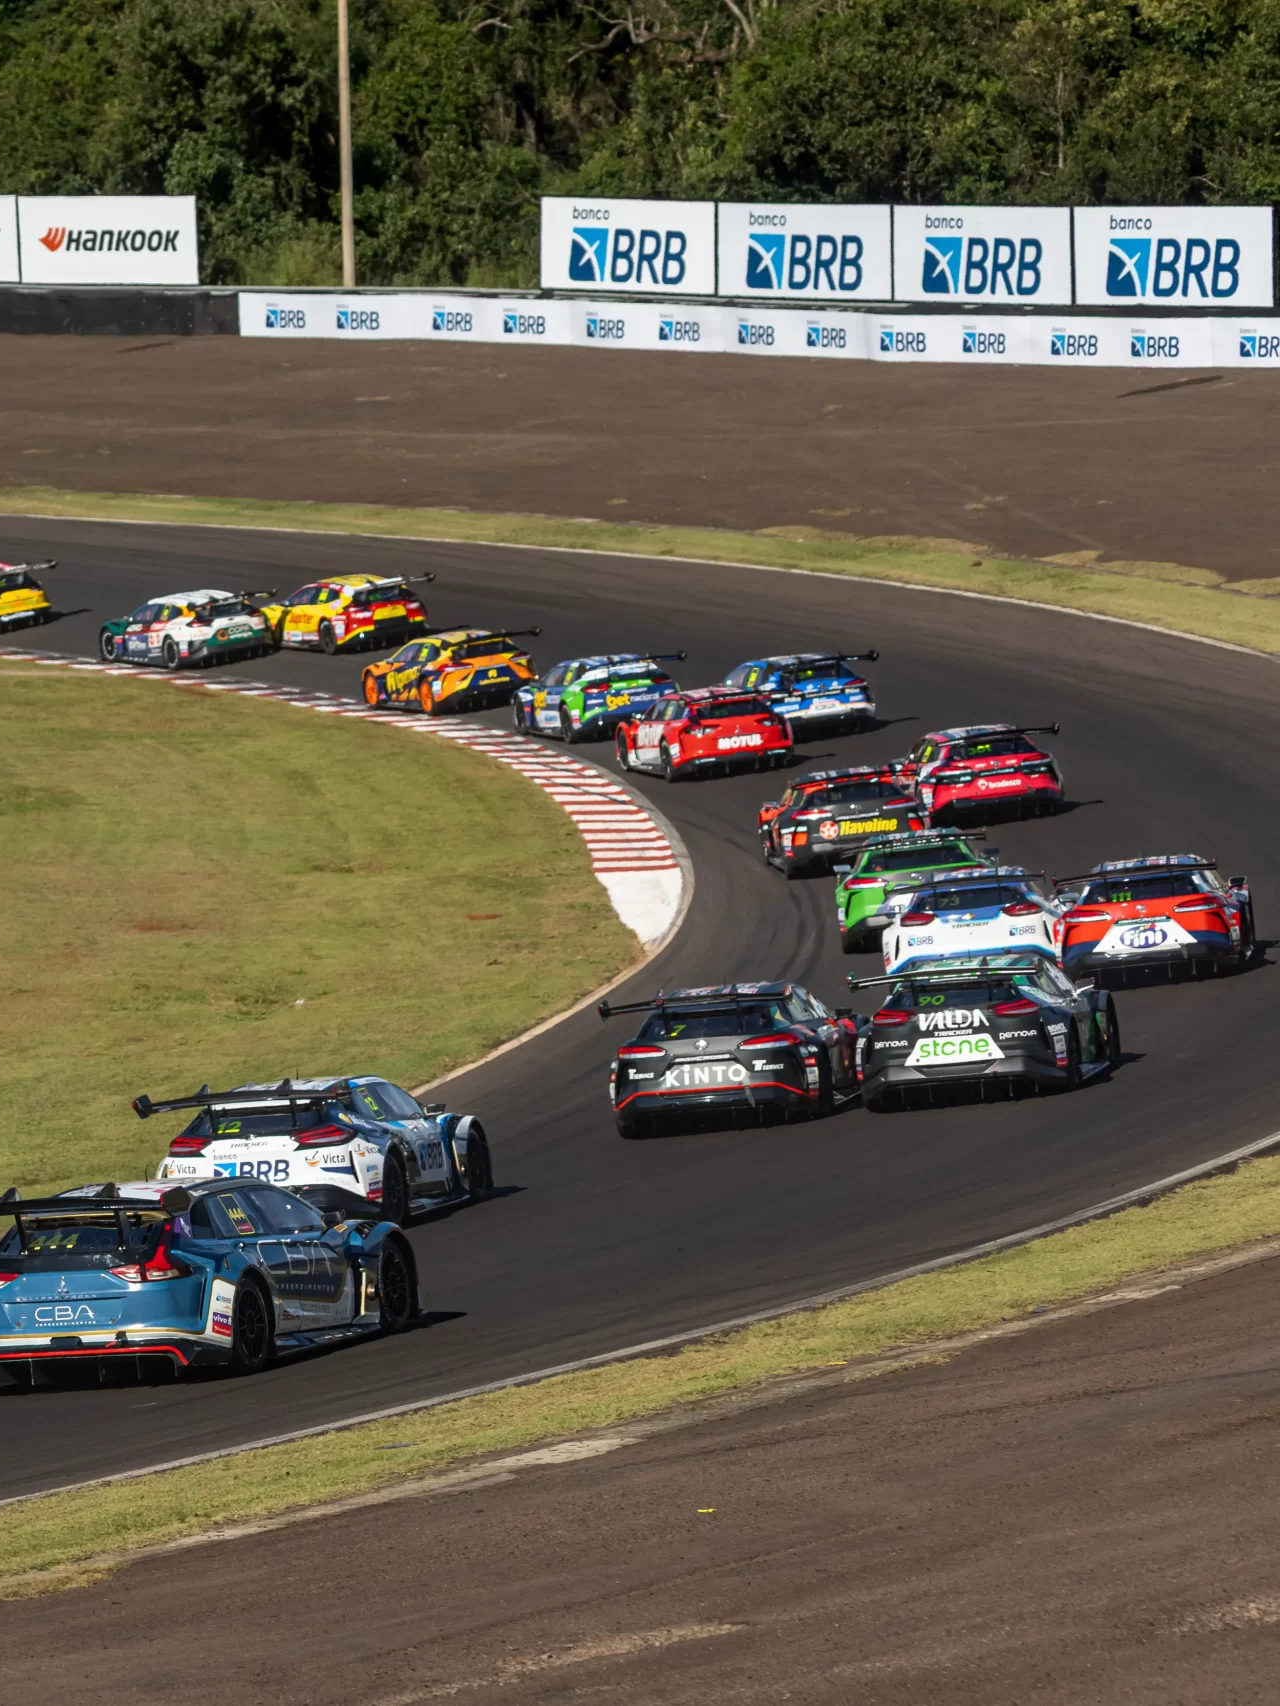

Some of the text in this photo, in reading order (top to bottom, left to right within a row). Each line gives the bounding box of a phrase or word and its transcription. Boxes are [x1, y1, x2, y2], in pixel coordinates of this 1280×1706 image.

[573, 206, 610, 220] banco
[749, 211, 787, 226] banco
[925, 214, 964, 229] banco
[1109, 215, 1153, 230] banco
[610, 229, 687, 285] BRB
[787, 234, 864, 291] BRB
[964, 237, 1042, 295] BRB
[1153, 238, 1241, 297] BRB
[279, 310, 306, 328] BRB
[350, 311, 380, 330] BRB
[446, 312, 473, 332] BRB
[518, 315, 546, 334] BRB
[598, 319, 625, 339] BRB
[674, 321, 701, 341] BRB
[750, 325, 775, 346] BRB
[821, 328, 847, 349] BRB
[895, 332, 927, 352] BRB
[978, 333, 1006, 354] BRB
[1067, 335, 1098, 355] BRB
[1147, 336, 1180, 357] BRB
[1258, 336, 1280, 357] BR
[718, 734, 763, 750] MOTUL
[989, 779, 1021, 789] bradesco
[840, 818, 898, 836] Havoline
[1111, 891, 1132, 902] 111
[1018, 925, 1036, 935] BRB
[916, 936, 934, 946] BRB
[919, 995, 945, 1006] 90
[918, 1009, 990, 1031] VALDA
[217, 1121, 242, 1134] 12
[322, 1154, 345, 1164] Victa
[176, 1164, 197, 1174] Victa
[240, 1159, 290, 1183] BRB
[29, 1233, 80, 1250] 444
[35, 1305, 95, 1322] CBA
